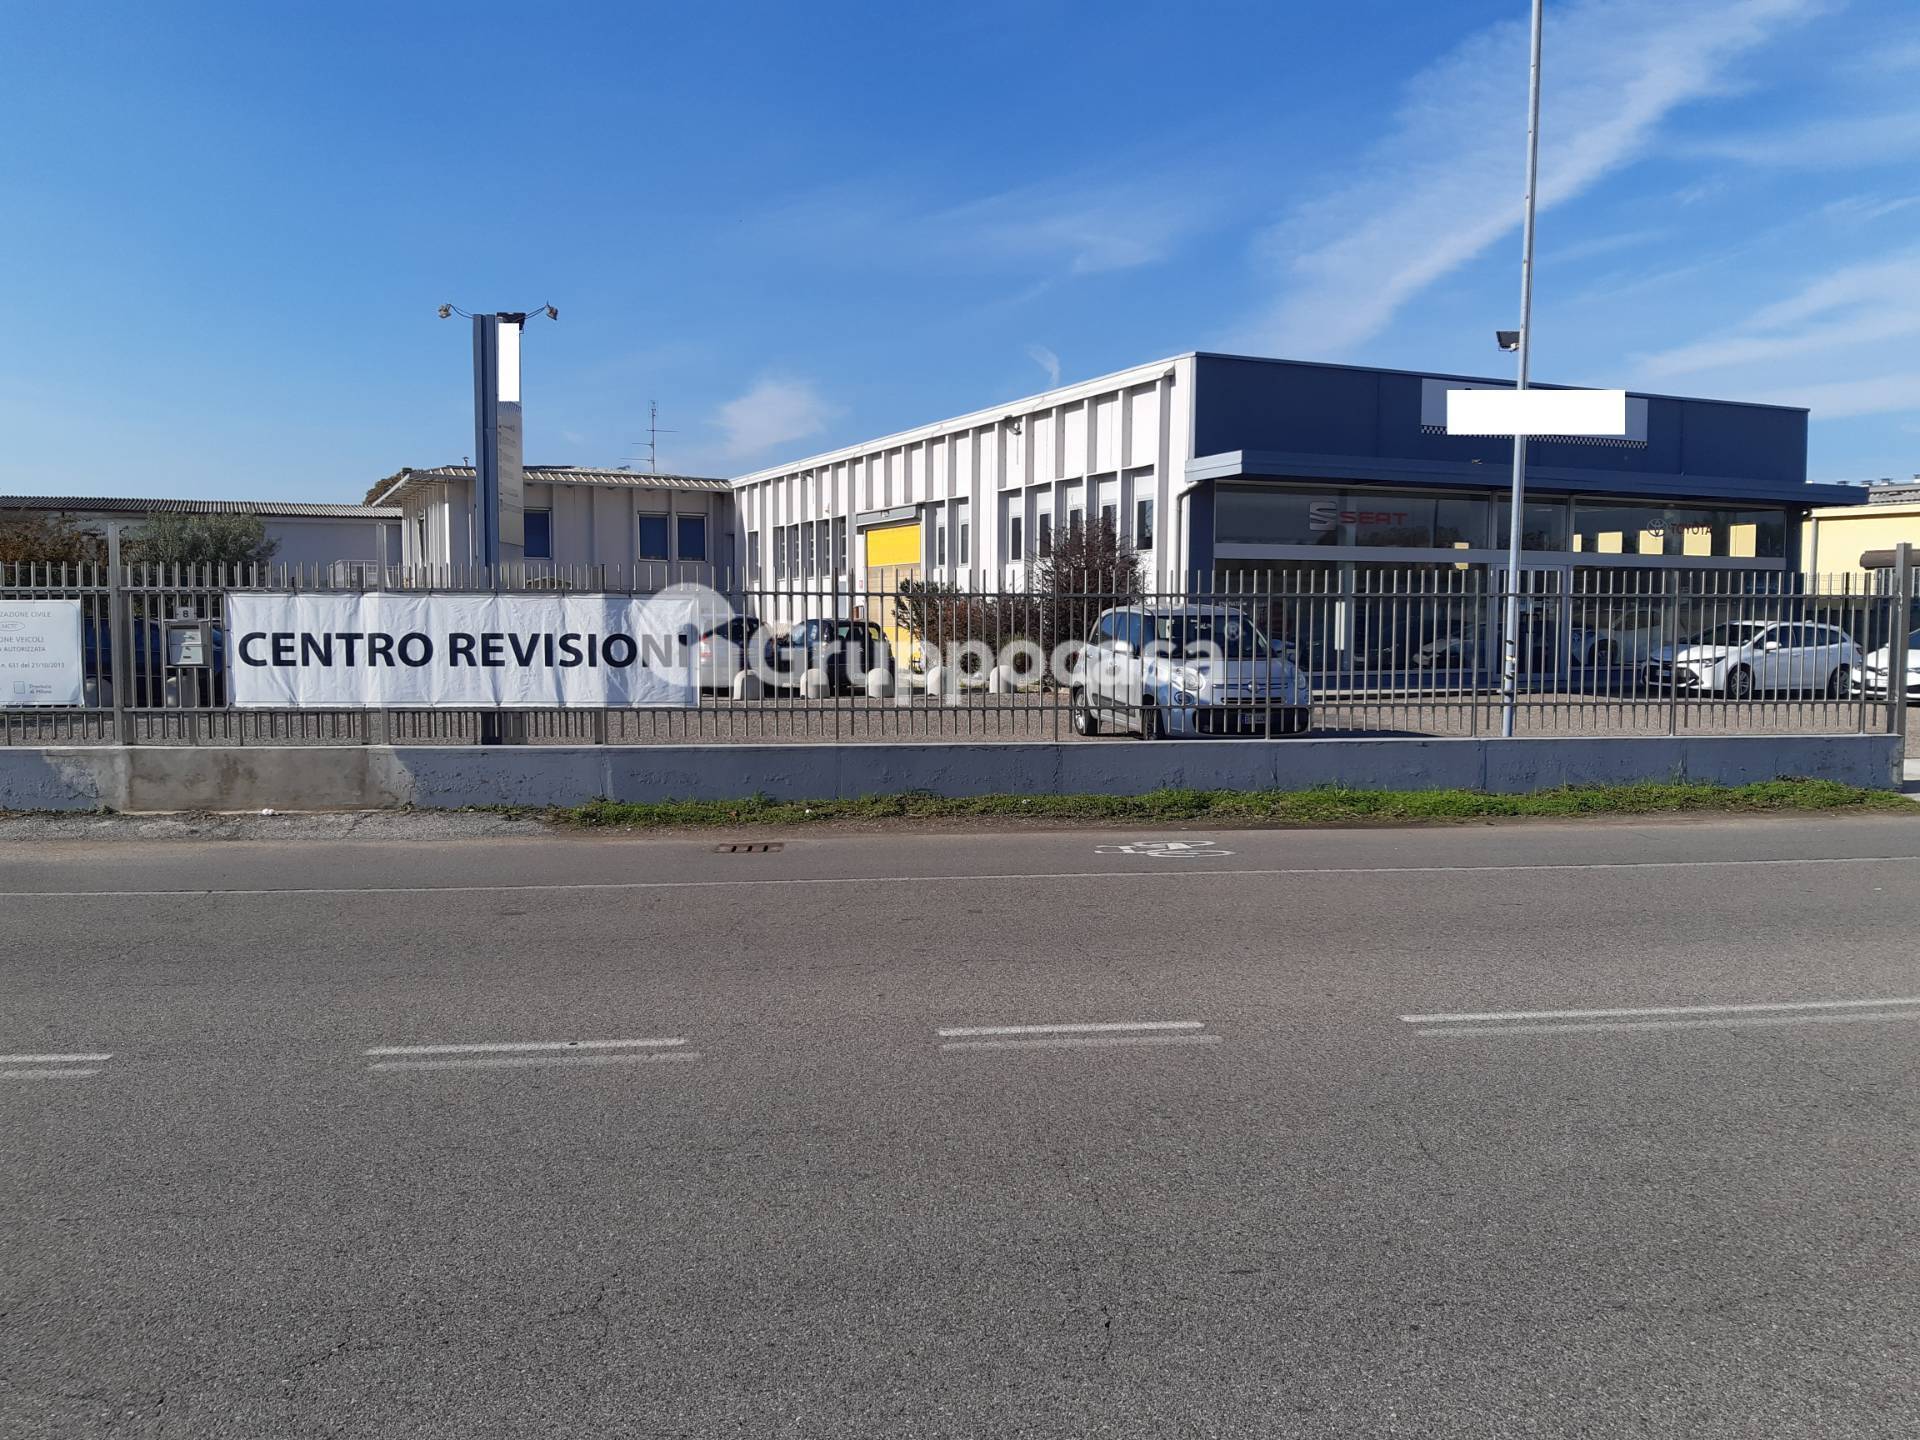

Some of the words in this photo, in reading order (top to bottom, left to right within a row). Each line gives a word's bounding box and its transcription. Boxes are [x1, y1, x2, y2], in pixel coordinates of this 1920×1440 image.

[1340, 511, 1408, 526] SEAT
[1671, 523, 1712, 536] TOYOTA
[238, 632, 433, 667] CENTRO
[449, 632, 687, 667] REVISIONI
